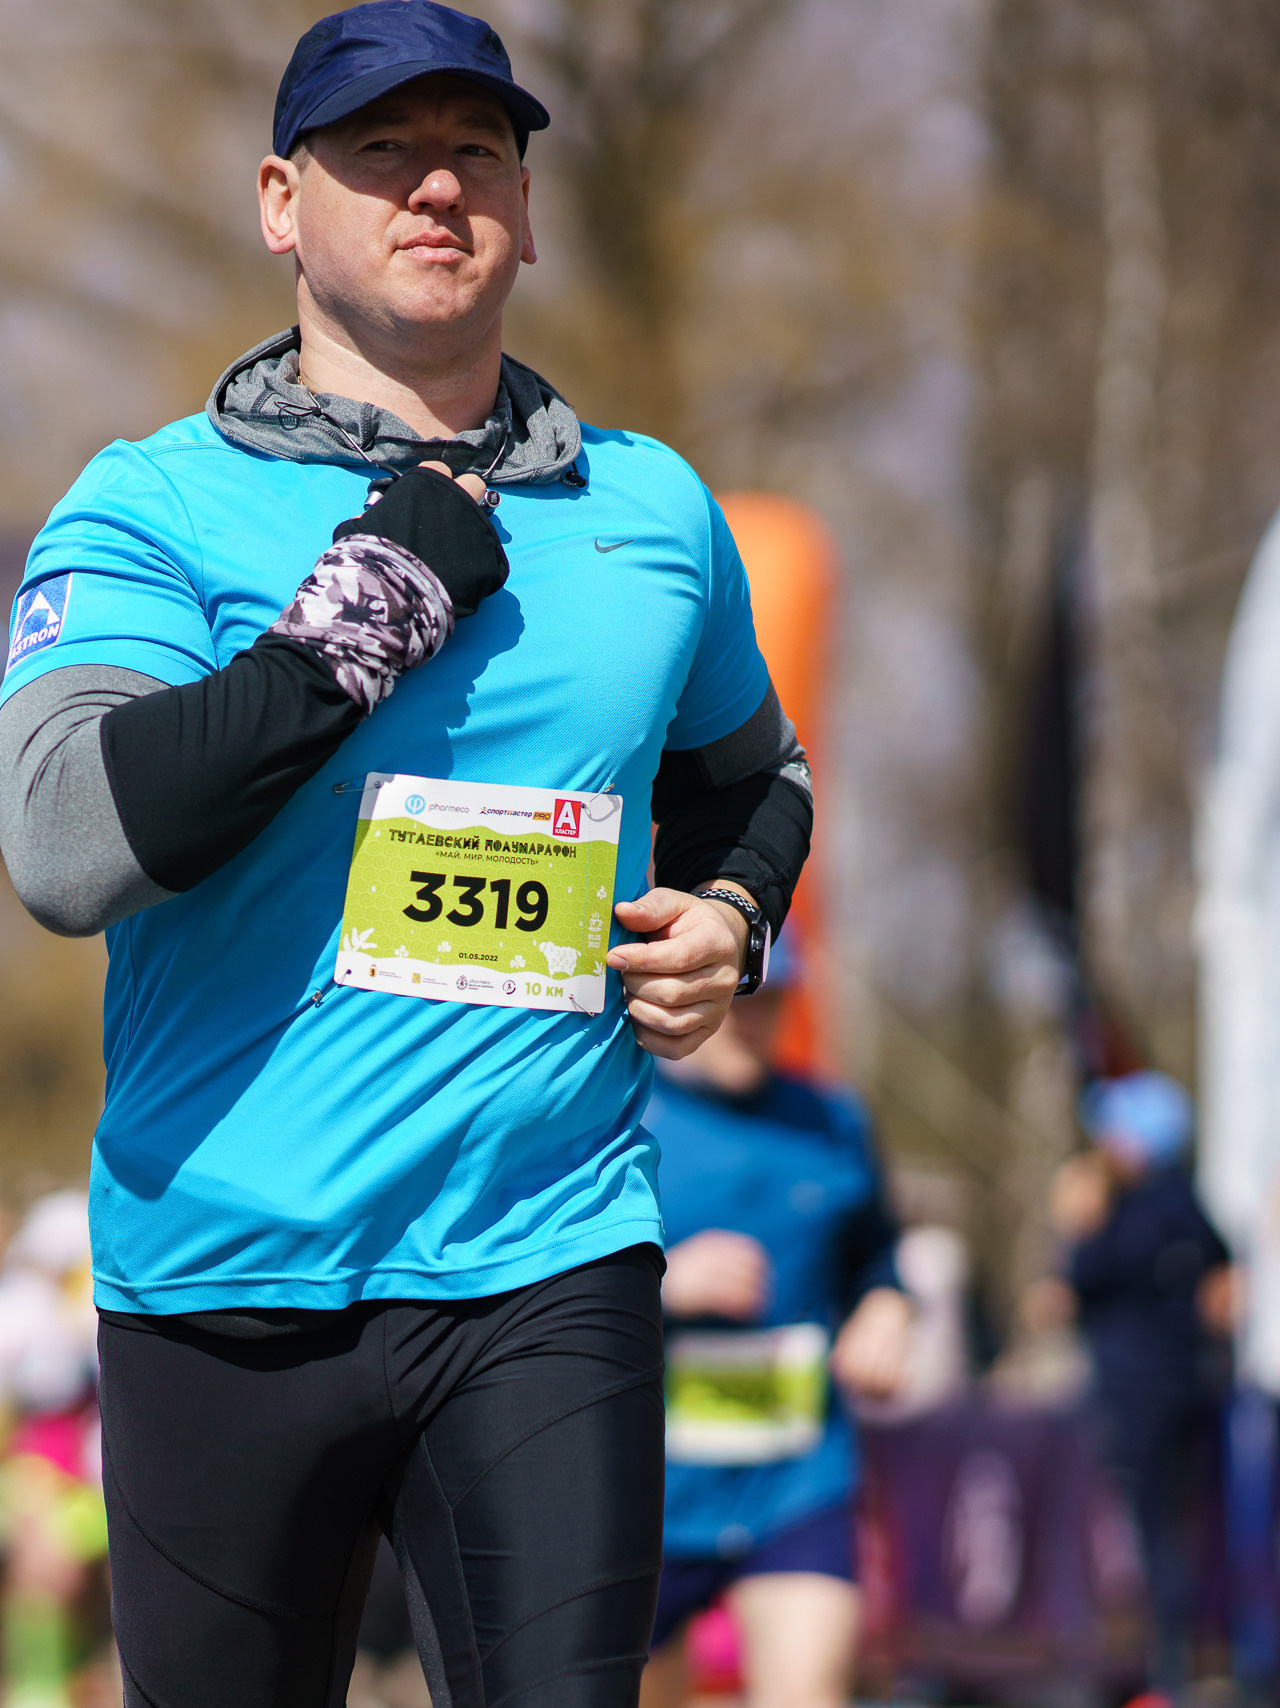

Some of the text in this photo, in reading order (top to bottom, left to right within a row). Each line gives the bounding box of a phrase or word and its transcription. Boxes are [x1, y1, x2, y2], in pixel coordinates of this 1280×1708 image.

[428, 803, 470, 813] pharmeco
[533, 812, 551, 820] PRO
[554, 828, 577, 836] КЛАСТЕР
[389, 828, 577, 858] ТУТАЕВСКИЙ ПОЛУМАРАФОН
[485, 855, 539, 866] МОЛОДОСТЬ»
[402, 870, 549, 932] 3319
[458, 952, 499, 962] 01.05.2022
[524, 982, 541, 996] 10
